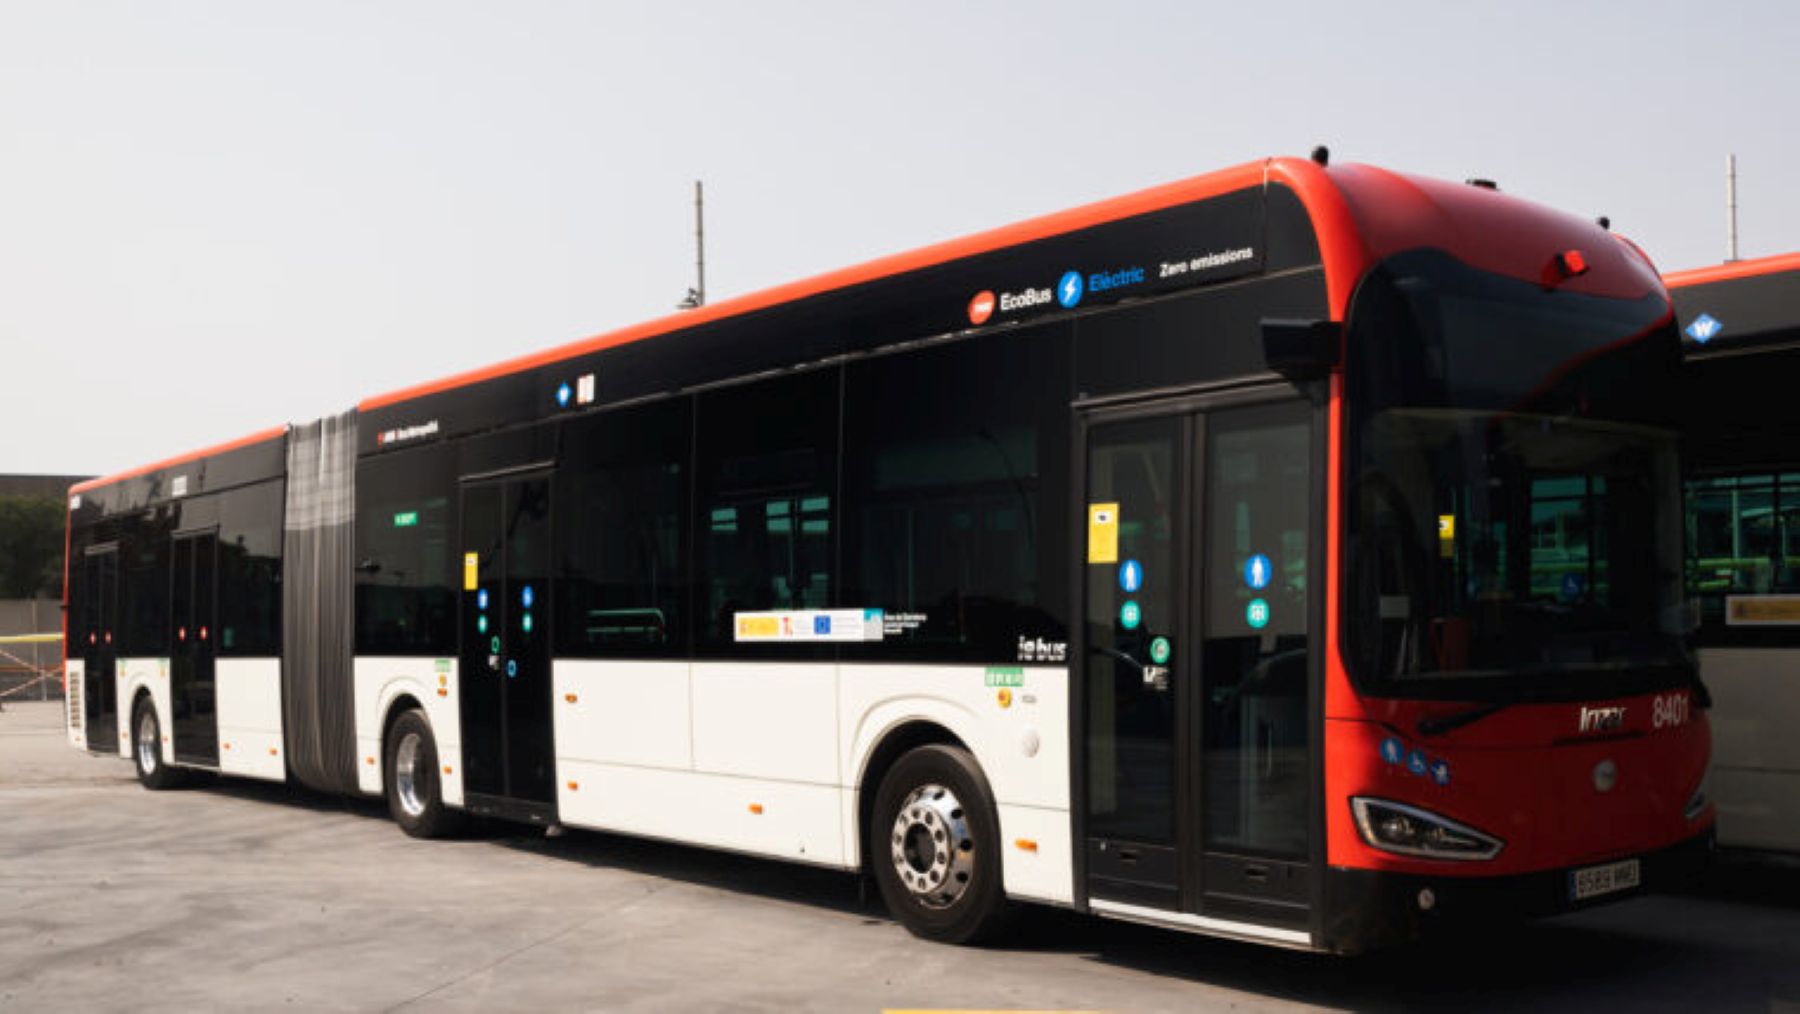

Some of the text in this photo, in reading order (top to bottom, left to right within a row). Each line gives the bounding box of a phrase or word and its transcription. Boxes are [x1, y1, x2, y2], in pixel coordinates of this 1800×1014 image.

[1000, 287, 1052, 311] EcoBus
[1088, 267, 1145, 292] Elèctric
[1159, 262, 1188, 278] Zero
[1190, 247, 1254, 271] emissions
[1652, 693, 1689, 728] 8401
